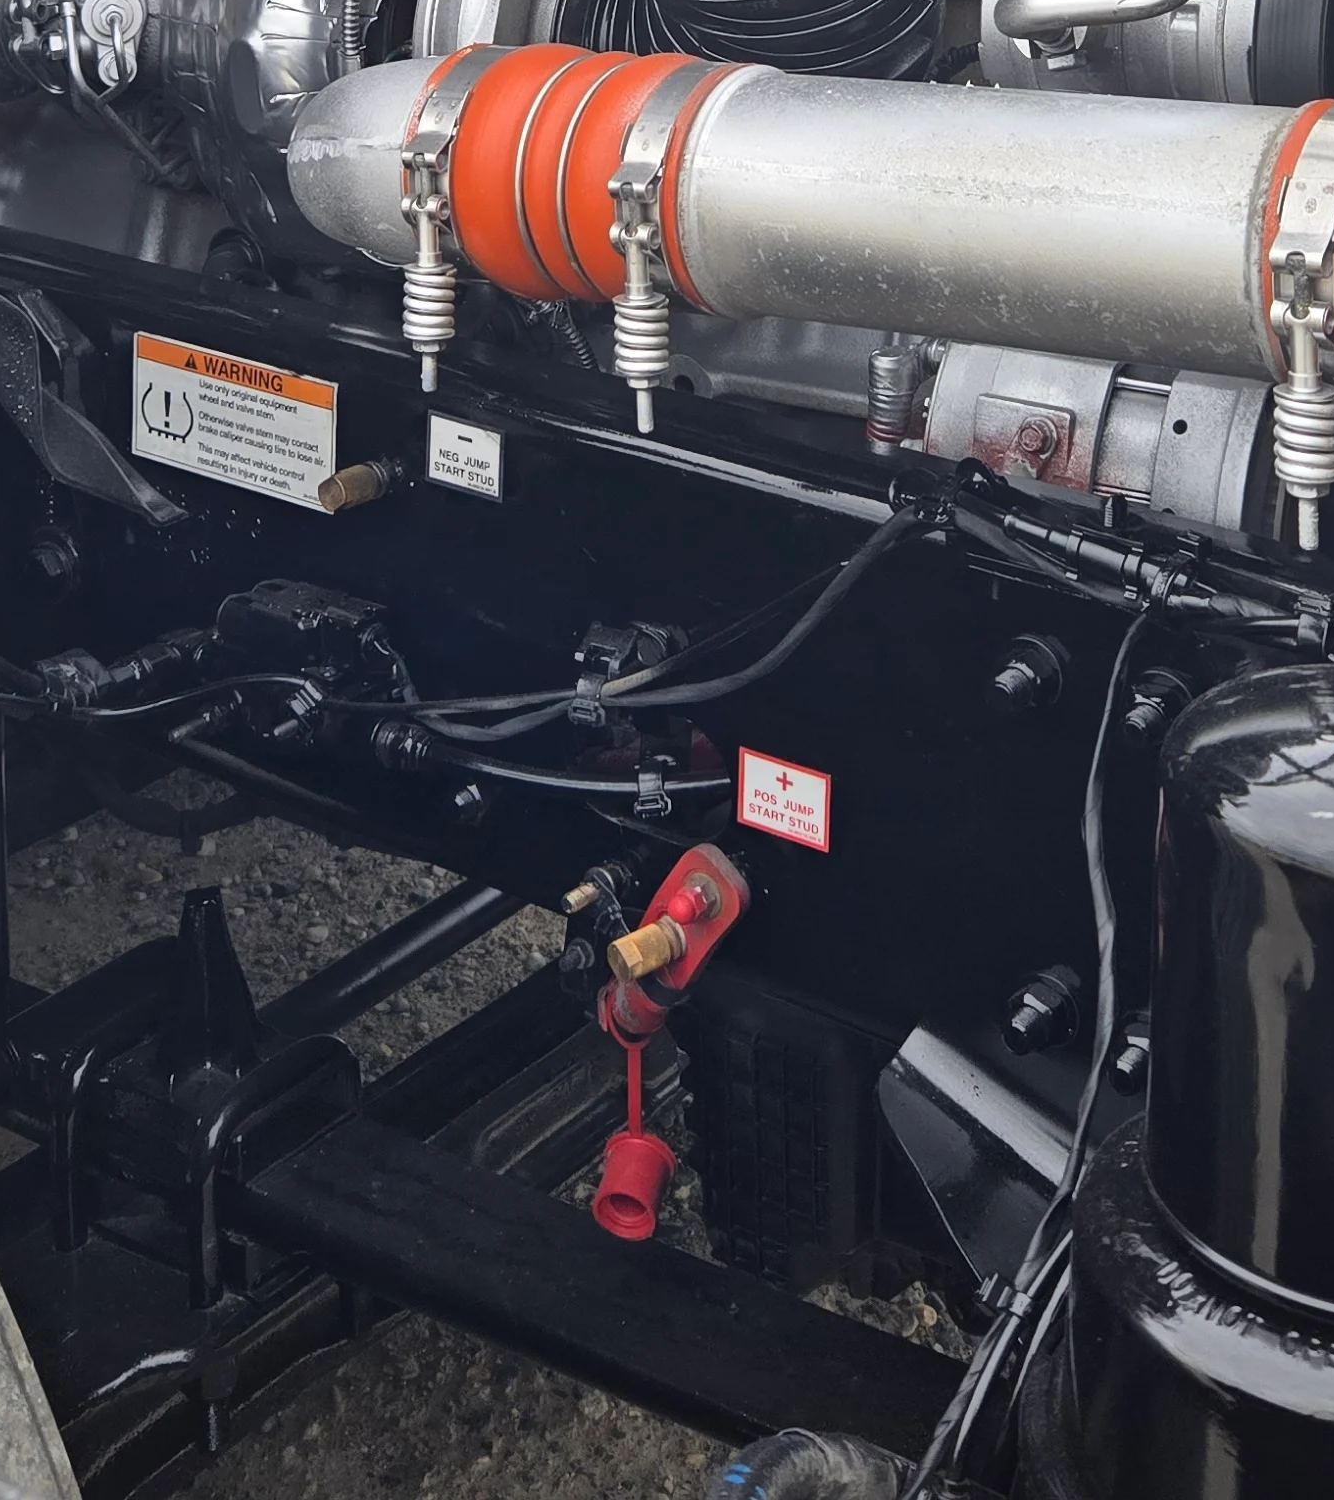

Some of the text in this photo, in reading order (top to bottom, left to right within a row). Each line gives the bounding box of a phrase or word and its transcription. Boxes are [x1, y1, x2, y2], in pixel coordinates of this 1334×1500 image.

[203, 356, 284, 393] WARNING
[198, 378, 298, 414] Use only original equipment
[198, 392, 276, 421] wheel and valve stem.
[198, 410, 319, 453] Otherwise valve stem may contact
[198, 422, 327, 468] brake caliper causing tire to lose air.
[197, 441, 305, 481] This may affect vehicle control
[197, 456, 292, 491] resulting in injury or death.
[434, 461, 495, 487] START STUD
[439, 448, 491, 471] NEG JUMP
[748, 803, 819, 835] START STUD
[754, 788, 815, 817] POS JUMP
